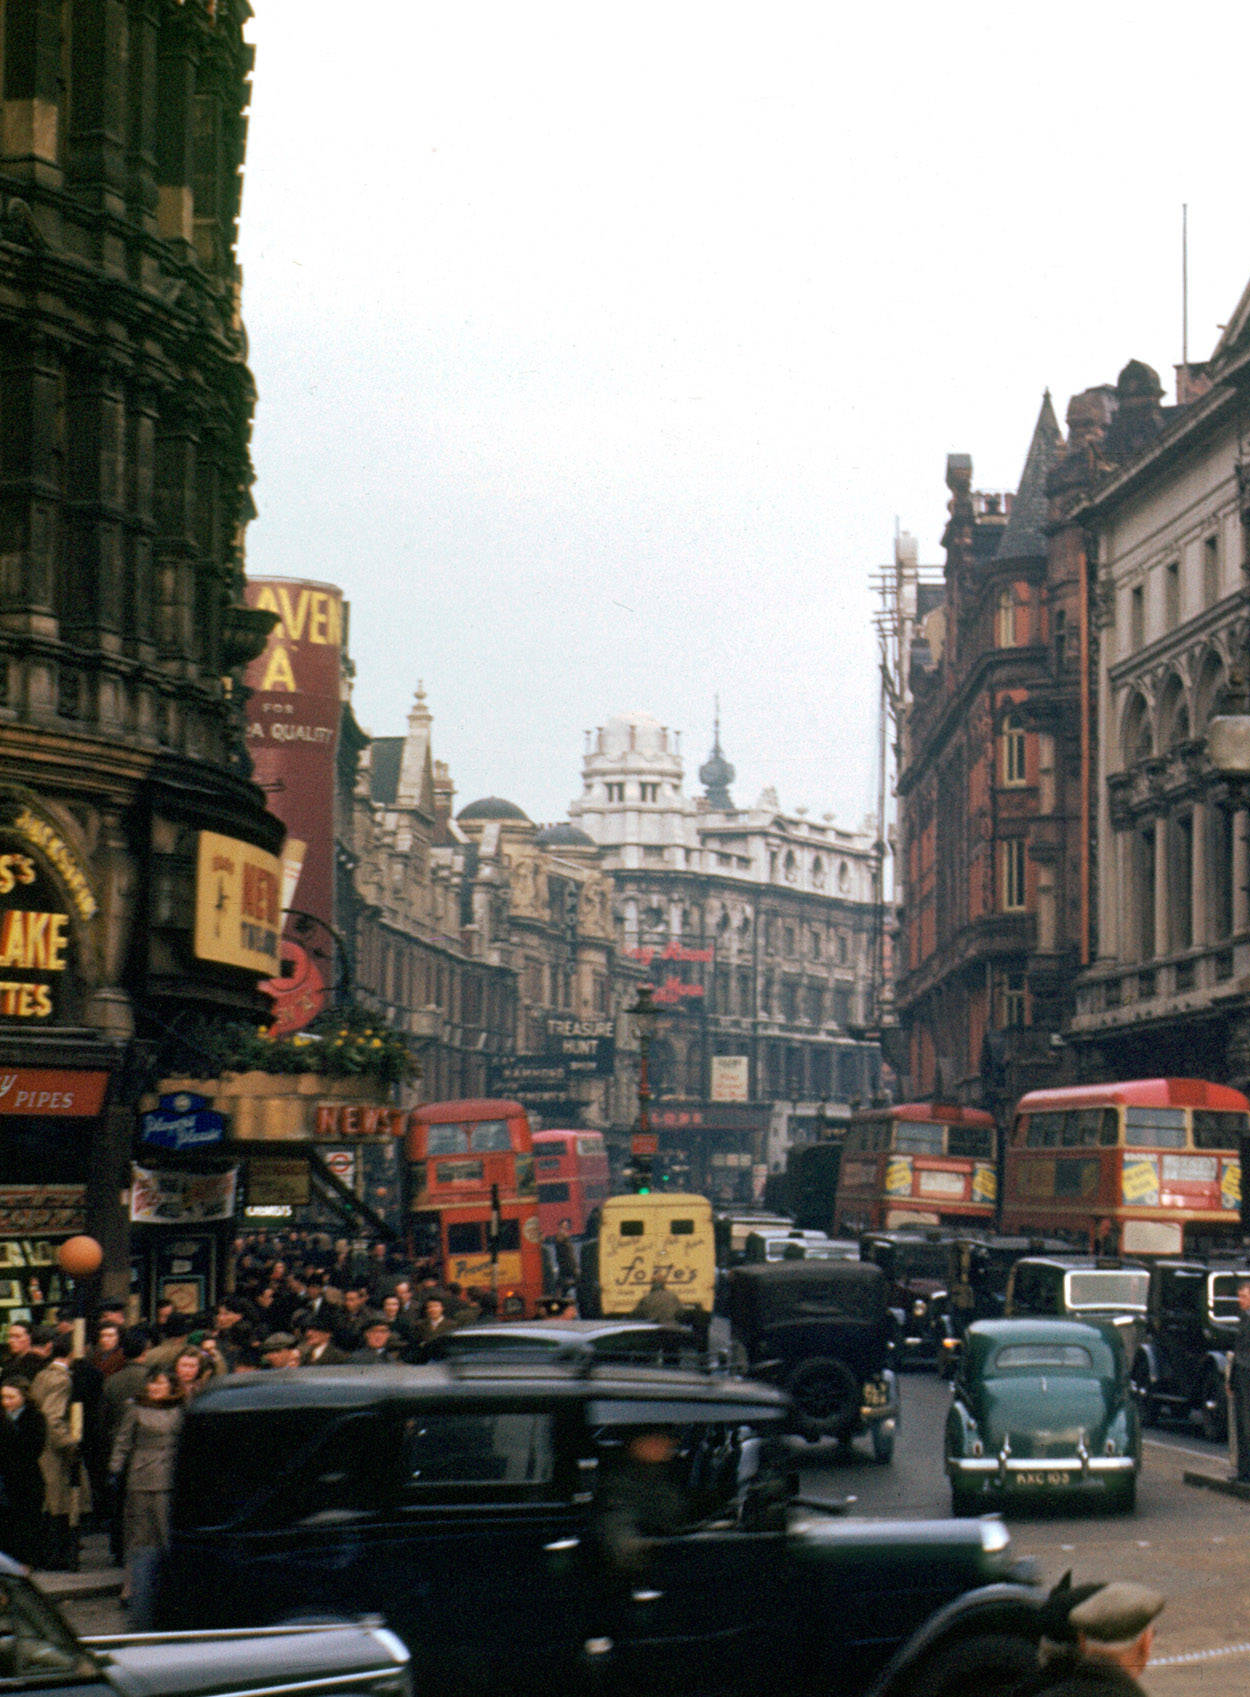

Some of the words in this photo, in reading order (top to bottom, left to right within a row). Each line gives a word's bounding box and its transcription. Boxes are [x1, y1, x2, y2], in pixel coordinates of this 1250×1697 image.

[0, 909, 69, 971] AKE
[547, 1019, 614, 1037] TREASURE
[562, 1039, 599, 1055] HUNT
[14, 1090, 76, 1109] PIPES
[315, 1105, 396, 1136] NEWS
